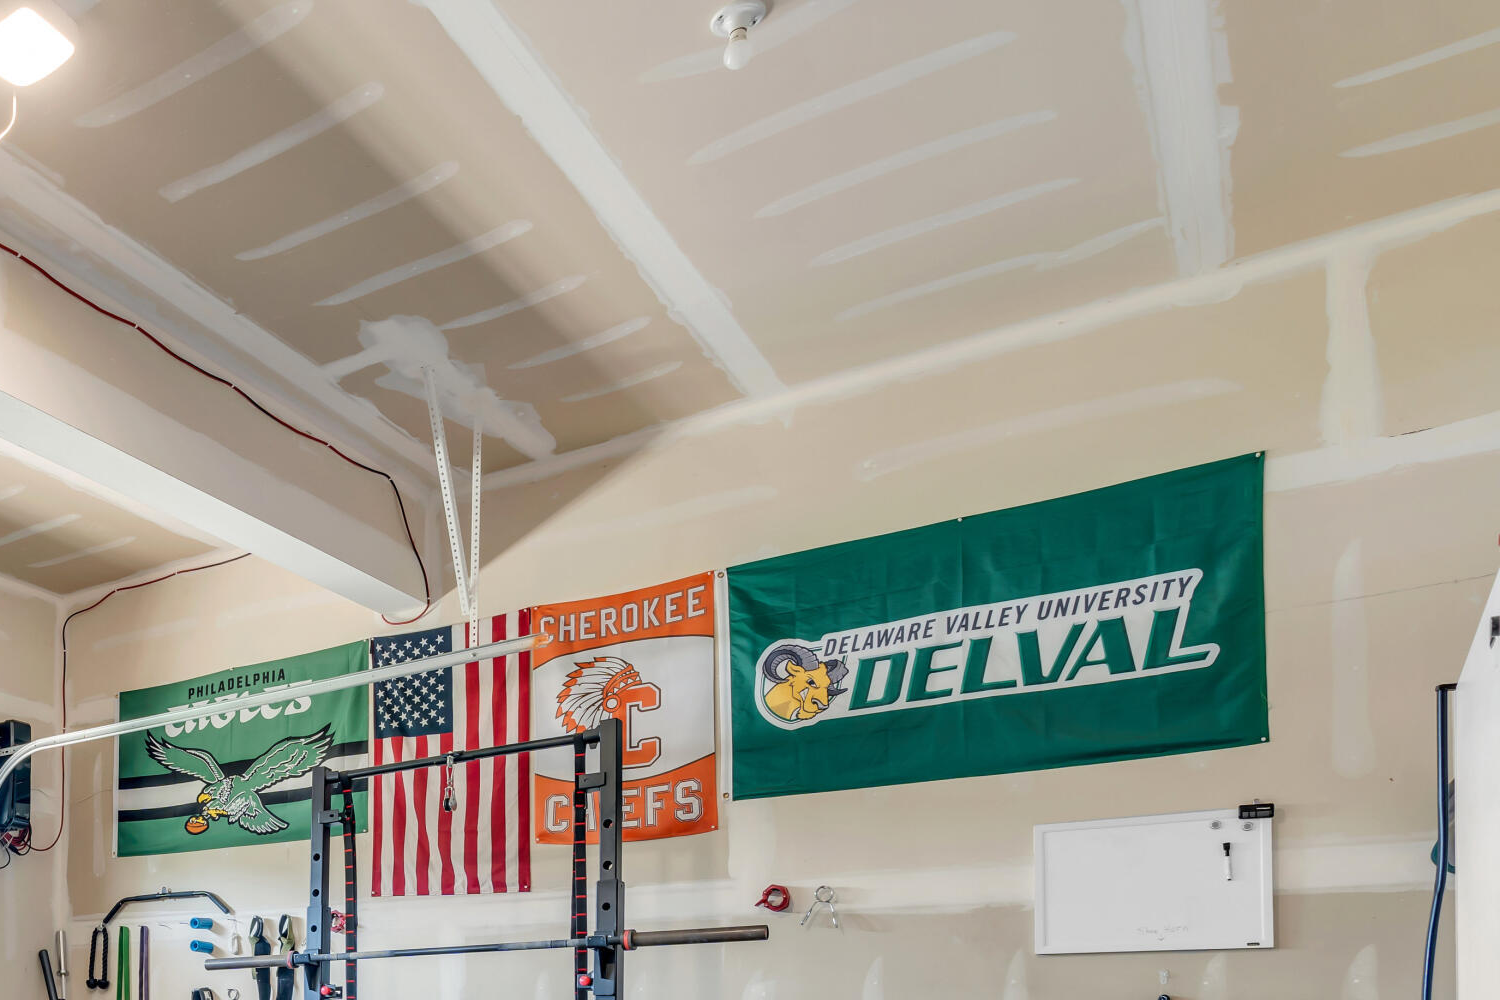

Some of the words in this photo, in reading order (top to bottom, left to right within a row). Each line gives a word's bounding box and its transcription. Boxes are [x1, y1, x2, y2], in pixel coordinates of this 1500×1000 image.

[538, 584, 708, 648] CHEROKEE
[823, 618, 937, 657] DELAWARE
[946, 603, 1029, 635] VALLEY
[1036, 575, 1194, 621] UNIVERSITY
[188, 668, 286, 700] PHILADELPHIA
[848, 606, 1211, 711] DELVAL
[545, 778, 703, 834] CEFS
